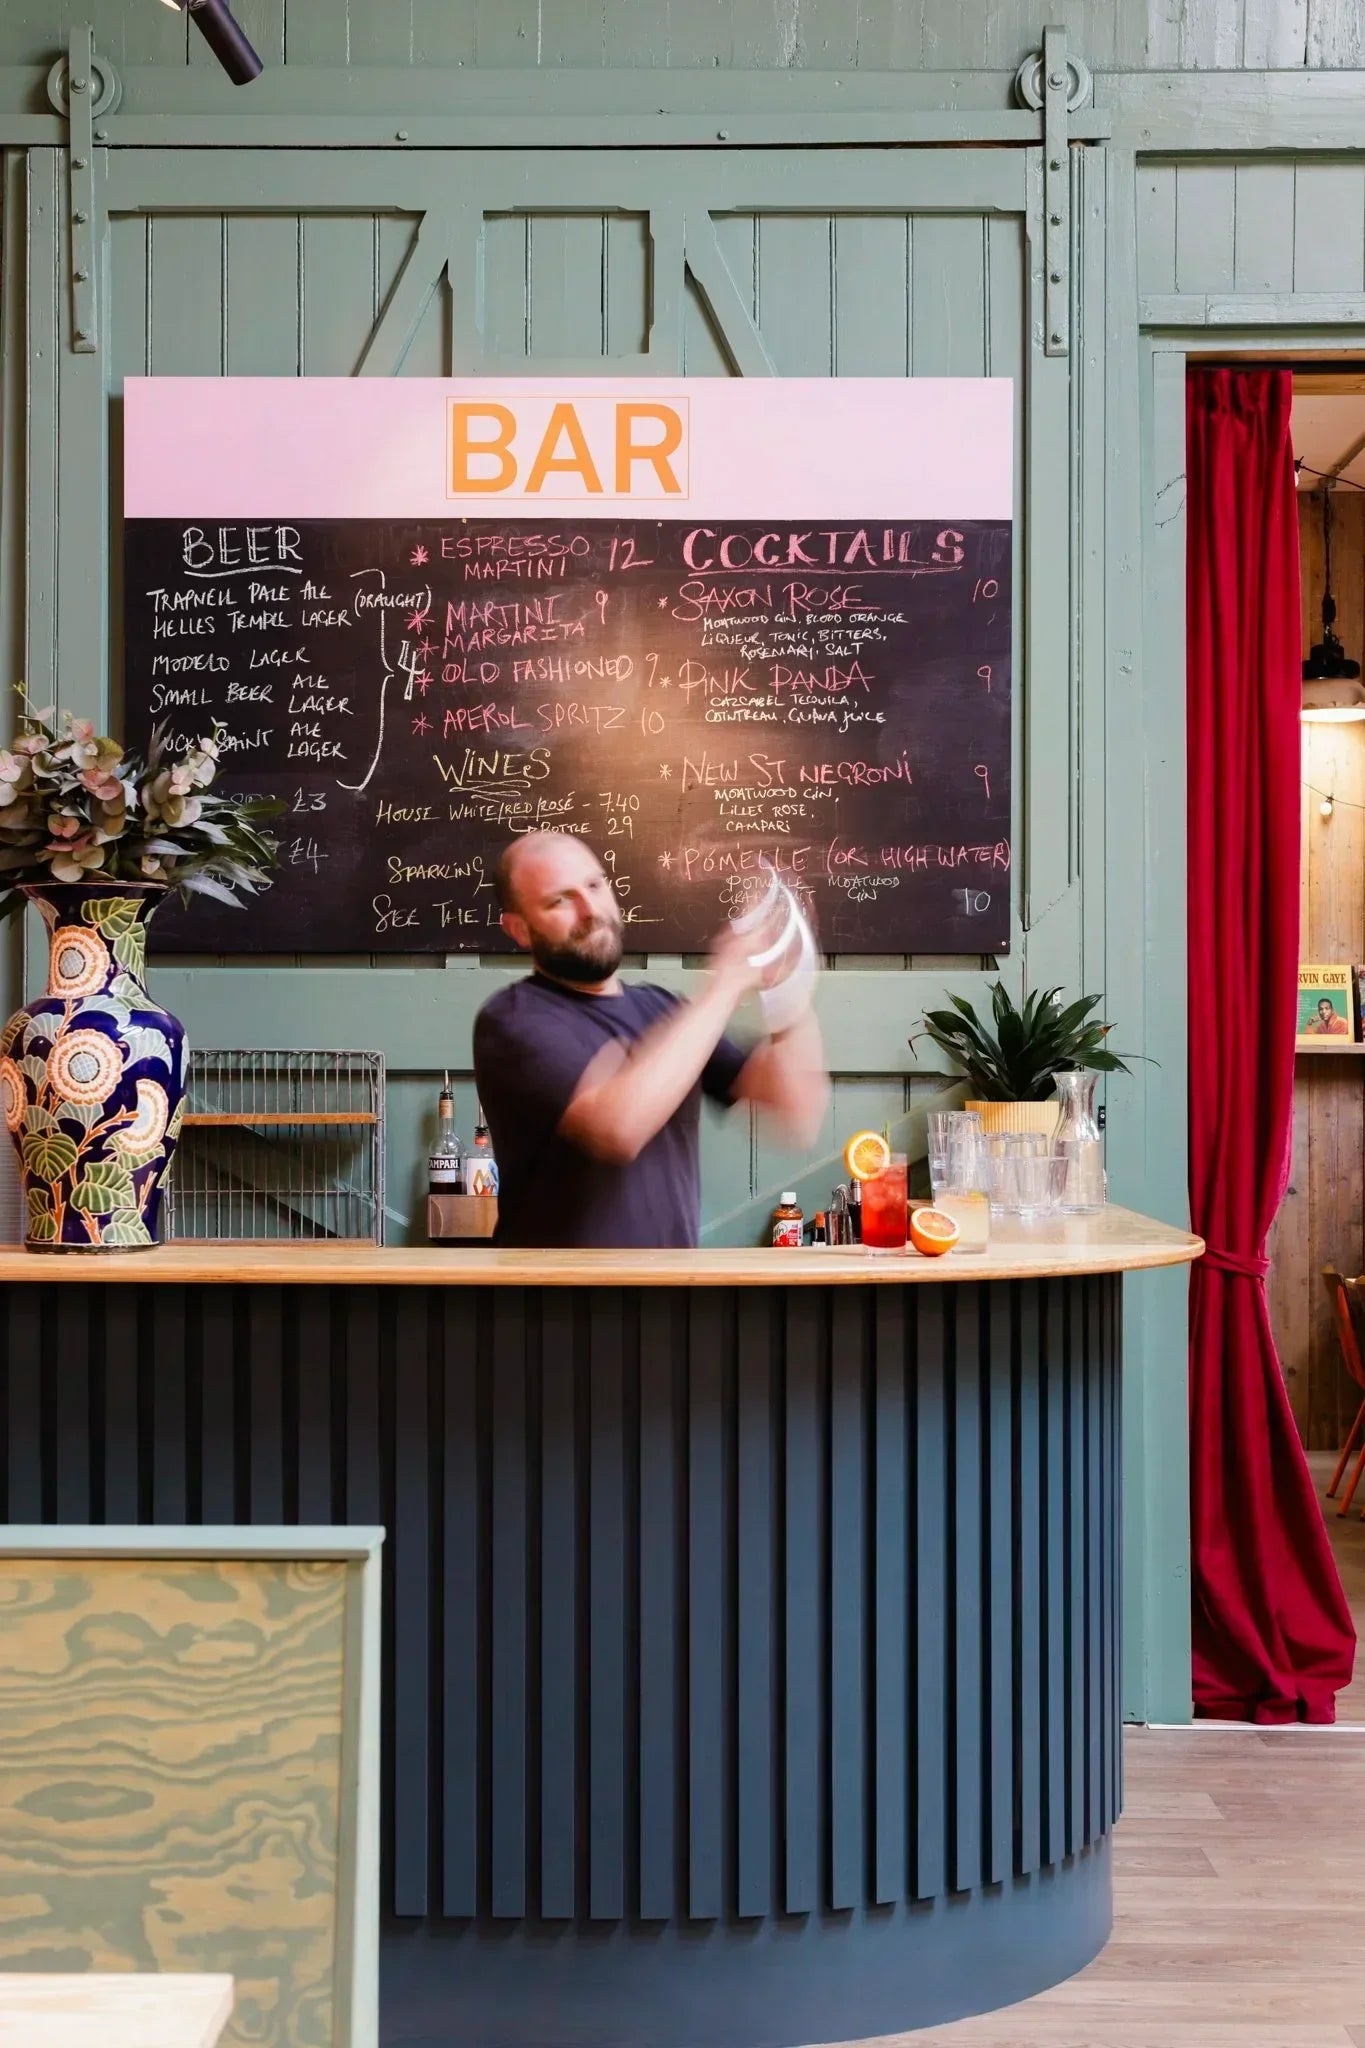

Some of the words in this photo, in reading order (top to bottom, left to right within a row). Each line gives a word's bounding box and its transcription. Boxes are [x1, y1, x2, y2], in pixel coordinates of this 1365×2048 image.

[453, 403, 683, 493] BAR
[183, 526, 303, 568] BEER
[441, 534, 590, 559] ESPRESSO
[609, 537, 655, 571] 12
[683, 528, 965, 570] COCKTAILS
[464, 556, 566, 581] MARTINI
[146, 588, 238, 613] TRAPNELL
[248, 581, 291, 604] PALE
[300, 580, 332, 600] ALE
[672, 581, 772, 621] SAXON
[782, 582, 881, 616] ROSE
[972, 579, 999, 603] 10
[153, 615, 216, 640] HELLES
[227, 610, 293, 633] TEMPLE
[302, 609, 352, 628] LAGER
[446, 593, 564, 636] MARTINI
[595, 590, 609, 625] 9
[703, 616, 769, 632] MOATWOOD
[805, 613, 843, 625] BLOOD
[848, 612, 910, 625] ORANGE
[443, 622, 585, 660] MARGARITA
[825, 642, 864, 656] SALT
[153, 653, 231, 676] MODELO
[250, 647, 311, 669] LAGER
[442, 658, 501, 684] OLD
[513, 654, 633, 683] FASHIONED
[645, 652, 660, 688] 9
[292, 673, 330, 690] ALE
[678, 658, 757, 704] PINK
[769, 660, 876, 694] PANDA
[977, 665, 993, 693] 9
[150, 684, 213, 714] SMALL
[225, 682, 275, 704] BEER
[288, 695, 354, 716] LAGER
[290, 722, 322, 739] ALE
[444, 702, 534, 739] APEROL
[537, 702, 626, 735] SPRITZ
[641, 706, 665, 737] 10
[788, 708, 838, 725] GUAVA
[838, 711, 887, 733] JUICE
[215, 729, 273, 753] SAINT
[287, 742, 348, 763] LAGER
[433, 748, 551, 786] WINES
[682, 751, 738, 794] NEW
[749, 753, 787, 788] ST
[799, 750, 913, 786] NEGRONI
[714, 787, 798, 801] MOATWOOD
[974, 764, 991, 799] 9
[376, 800, 441, 827] HOUSE
[599, 792, 640, 812] 7.40
[719, 803, 763, 817] LILLET
[607, 815, 634, 840] 29
[726, 819, 792, 834] CAMPARI
[603, 850, 616, 873] 9
[881, 847, 929, 870] HIGH
[387, 855, 496, 896] SPARKLING
[847, 887, 878, 901] GIN
[965, 887, 992, 915] 10
[372, 894, 421, 933] SEE
[432, 899, 480, 928] THE
[1322, 973, 1347, 984] GAYE
[429, 1159, 460, 1169] AMPARI
